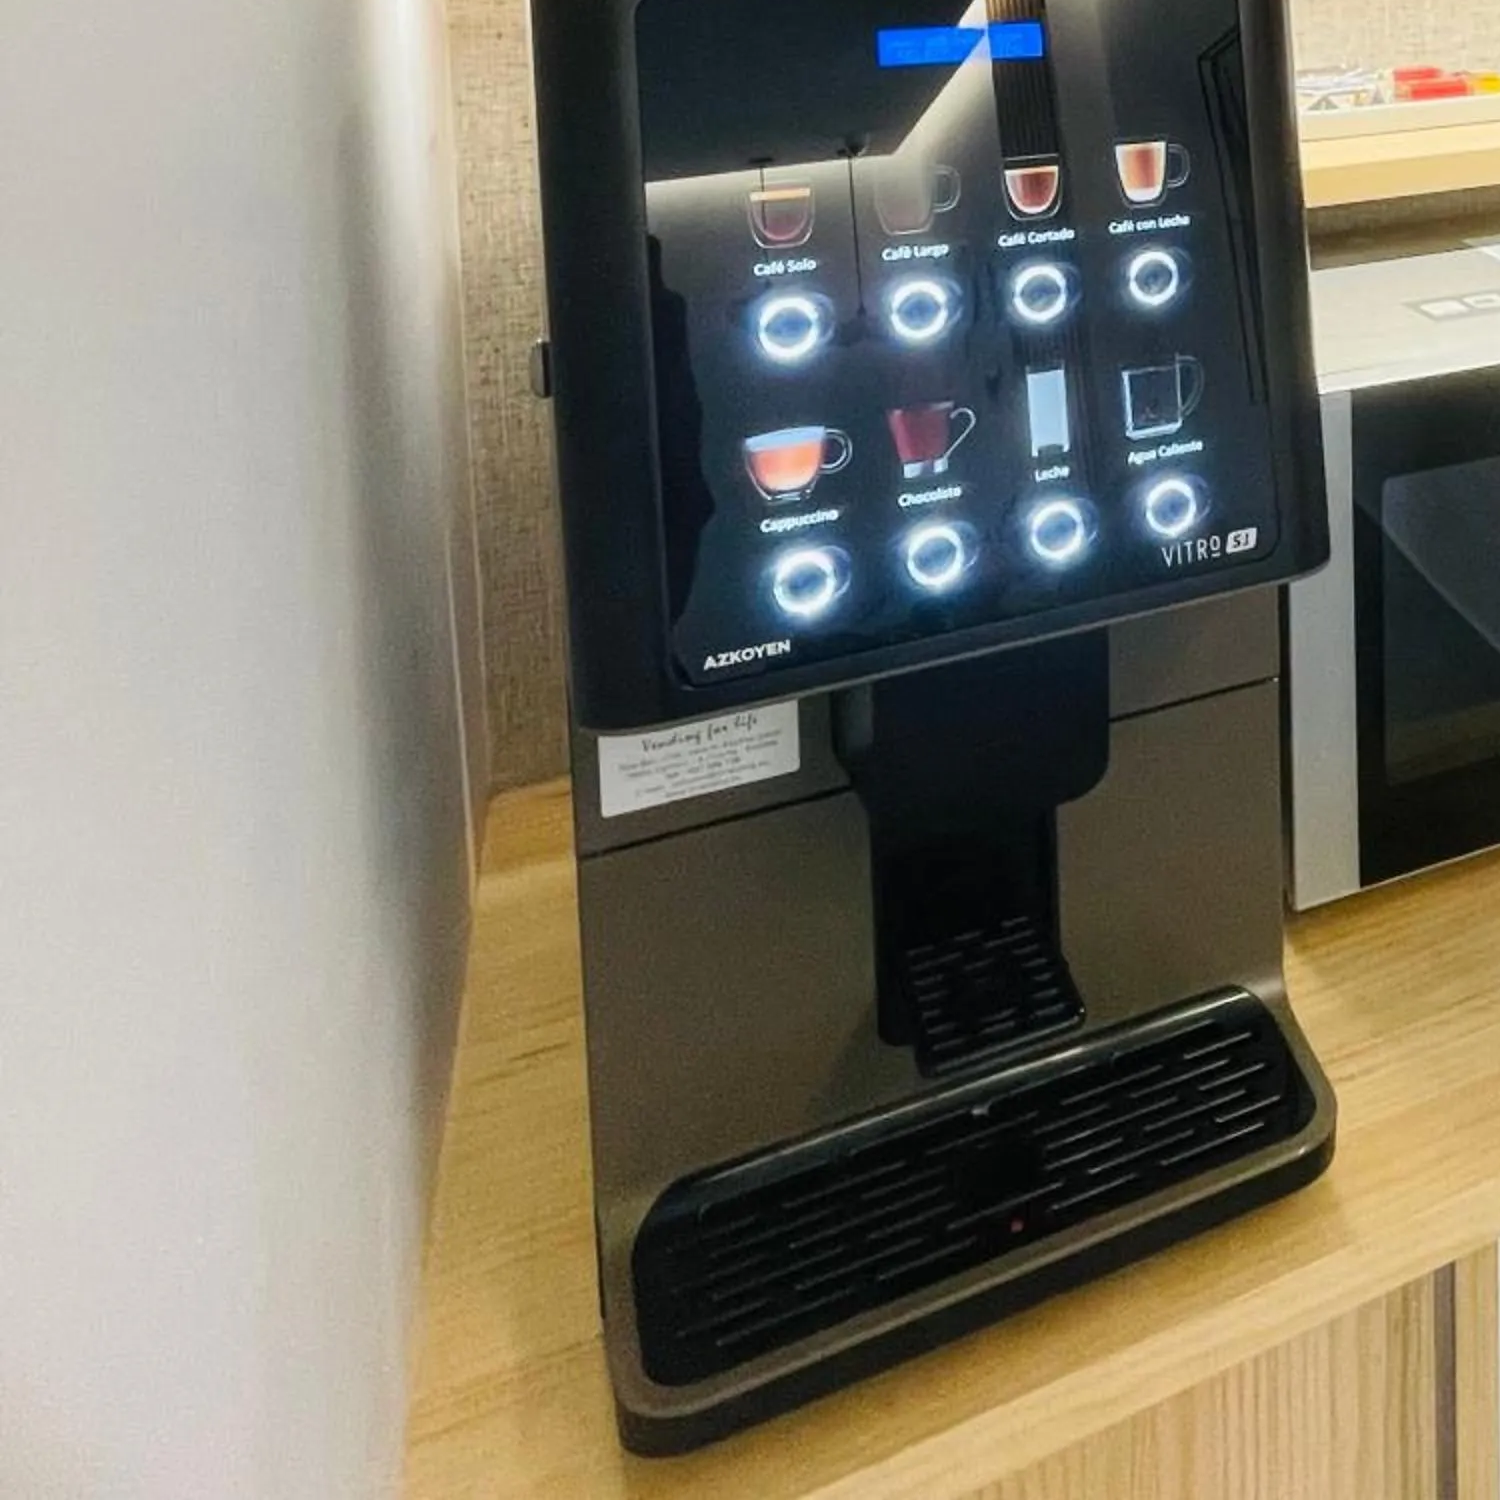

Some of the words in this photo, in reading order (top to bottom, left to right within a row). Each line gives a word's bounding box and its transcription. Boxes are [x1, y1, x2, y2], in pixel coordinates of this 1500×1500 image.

[1136, 219, 1155, 232] con
[1157, 214, 1190, 229] Leche
[1028, 227, 1075, 244] Cortado
[914, 243, 949, 259] Largo
[753, 260, 783, 277] Café
[786, 258, 816, 272] Solo
[1127, 451, 1154, 466] Agua
[1157, 440, 1203, 459] Caliente
[1035, 466, 1070, 483] Leche
[898, 485, 962, 509] Chocolate
[760, 507, 838, 535] Cappuccino
[703, 639, 790, 670] AZKOYEN
